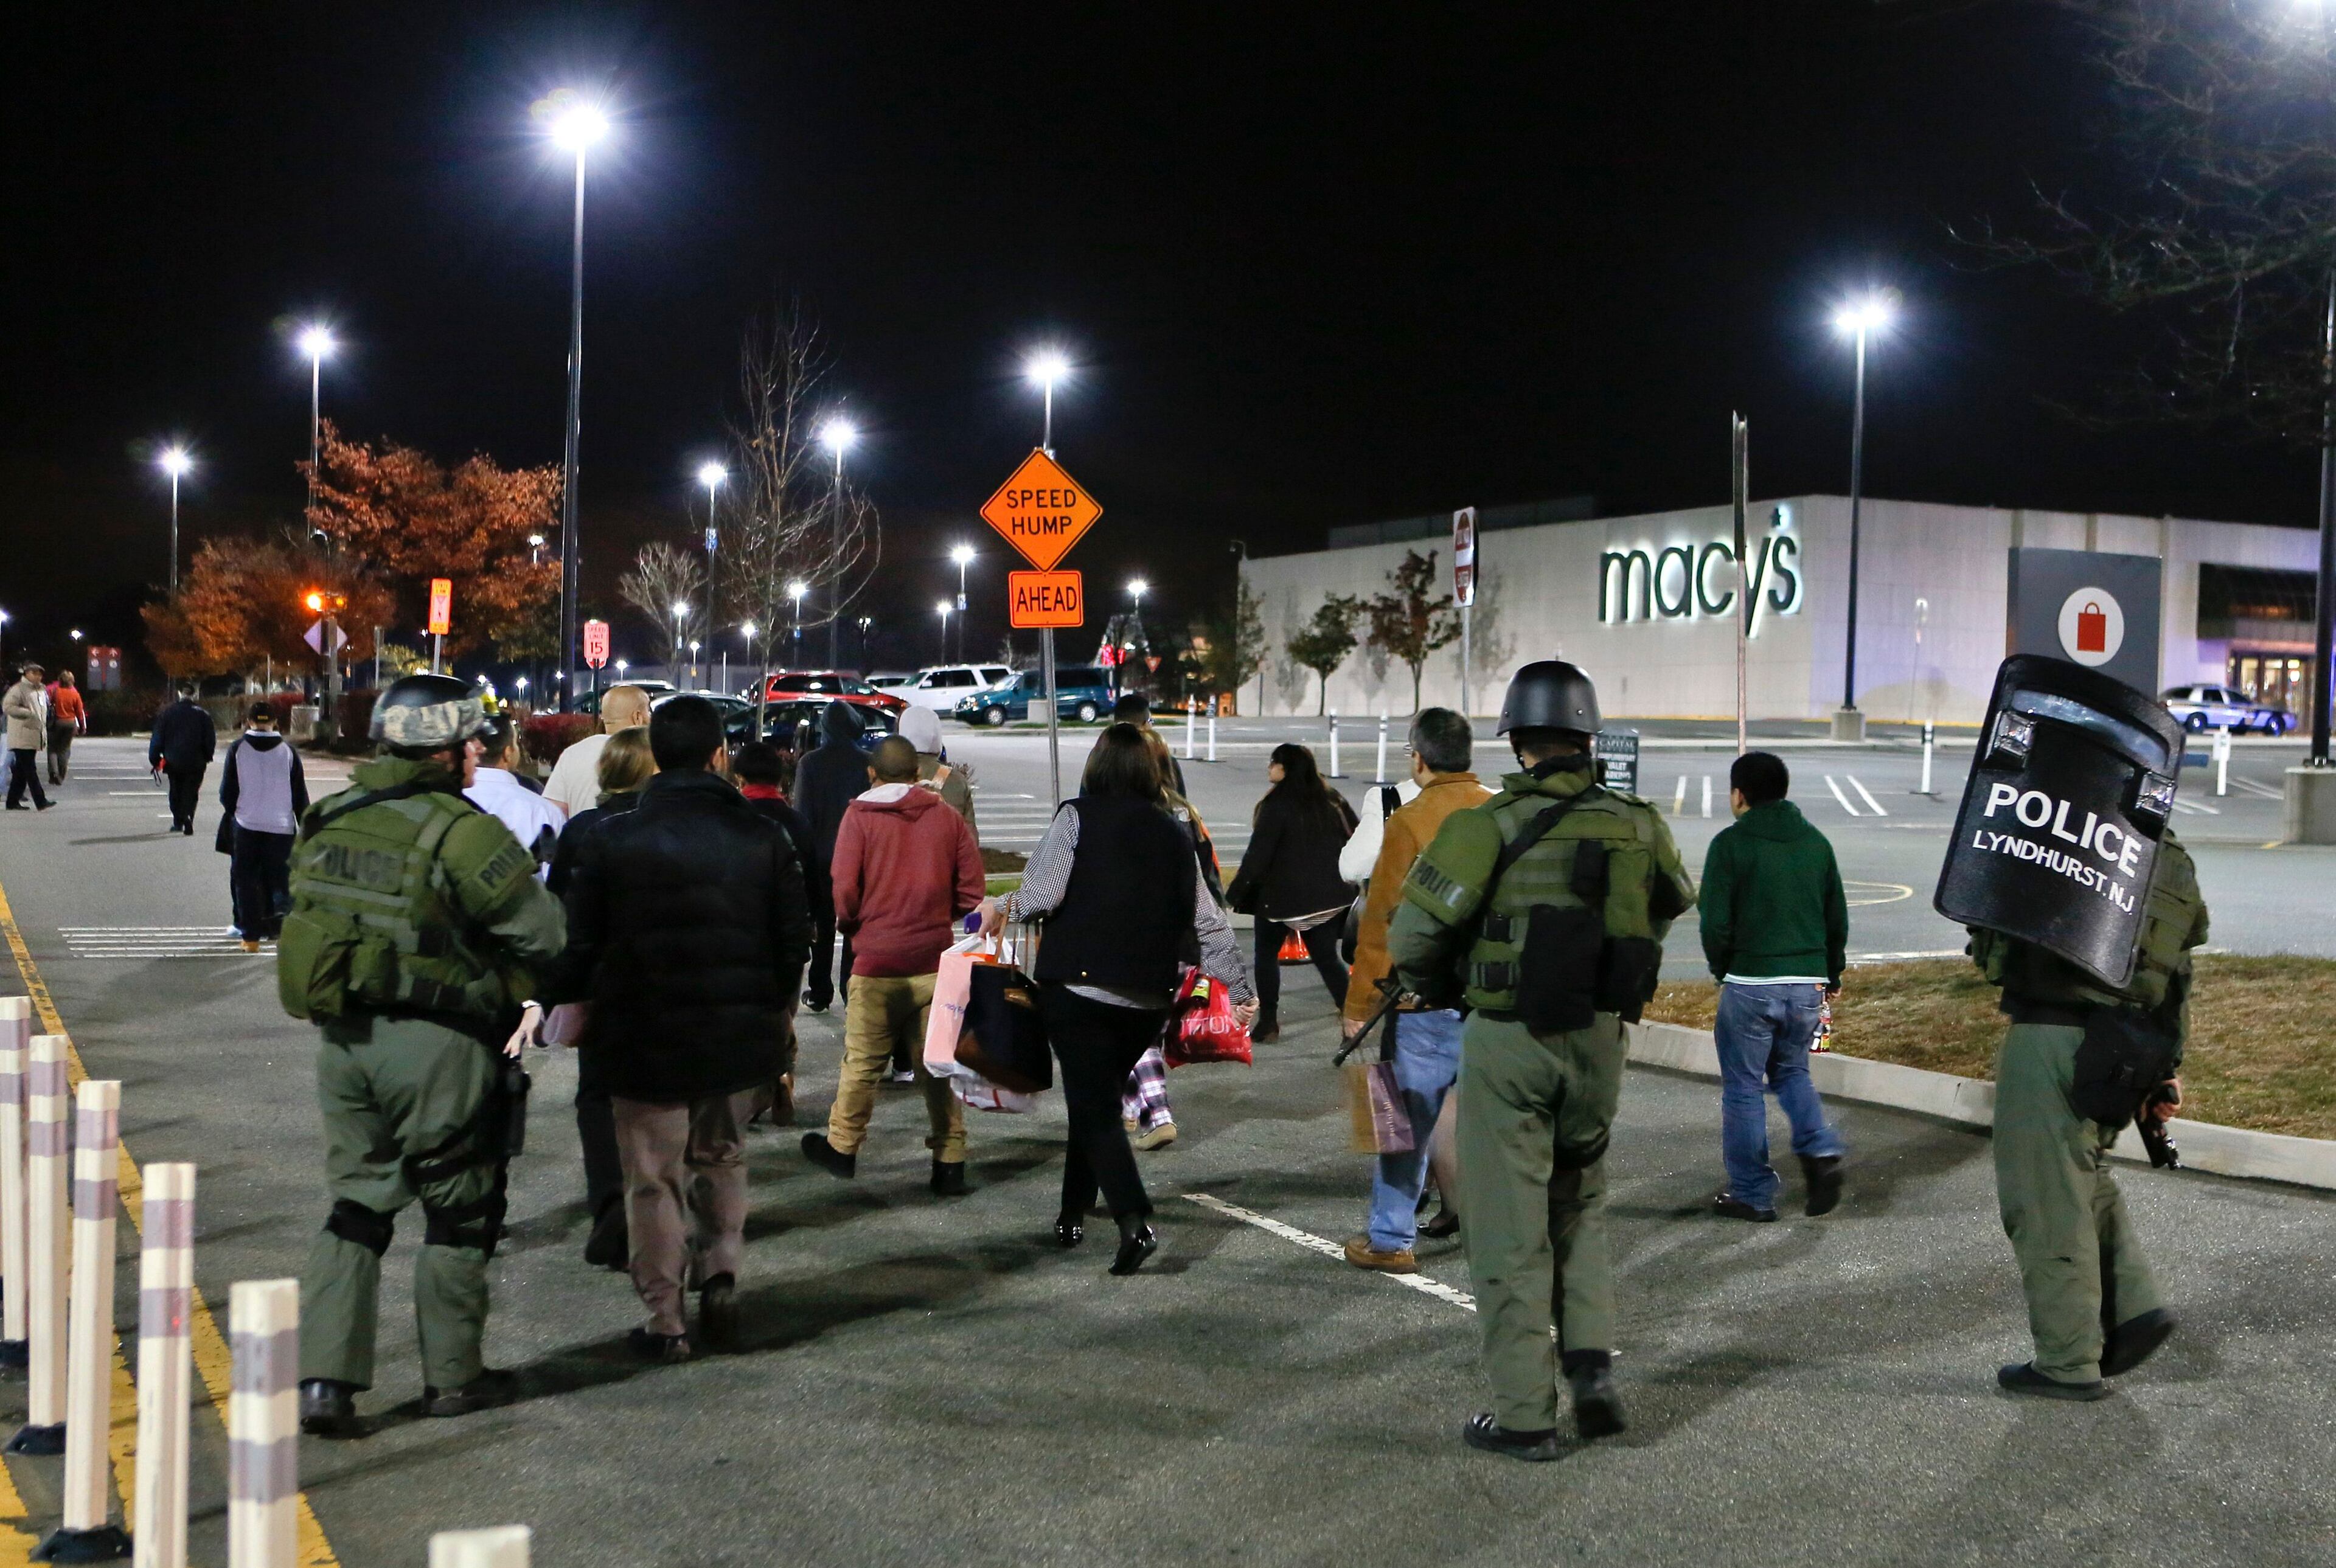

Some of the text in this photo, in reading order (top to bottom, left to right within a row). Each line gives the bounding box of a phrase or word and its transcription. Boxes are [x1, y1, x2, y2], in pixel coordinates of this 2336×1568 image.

[1006, 490, 1077, 509] SPEED
[1012, 516, 1072, 535] HUMP
[1016, 586, 1077, 612] AHEAD
[591, 642, 603, 654] 15
[1605, 770, 1631, 780] ARKING
[1984, 783, 2142, 878] POLICE
